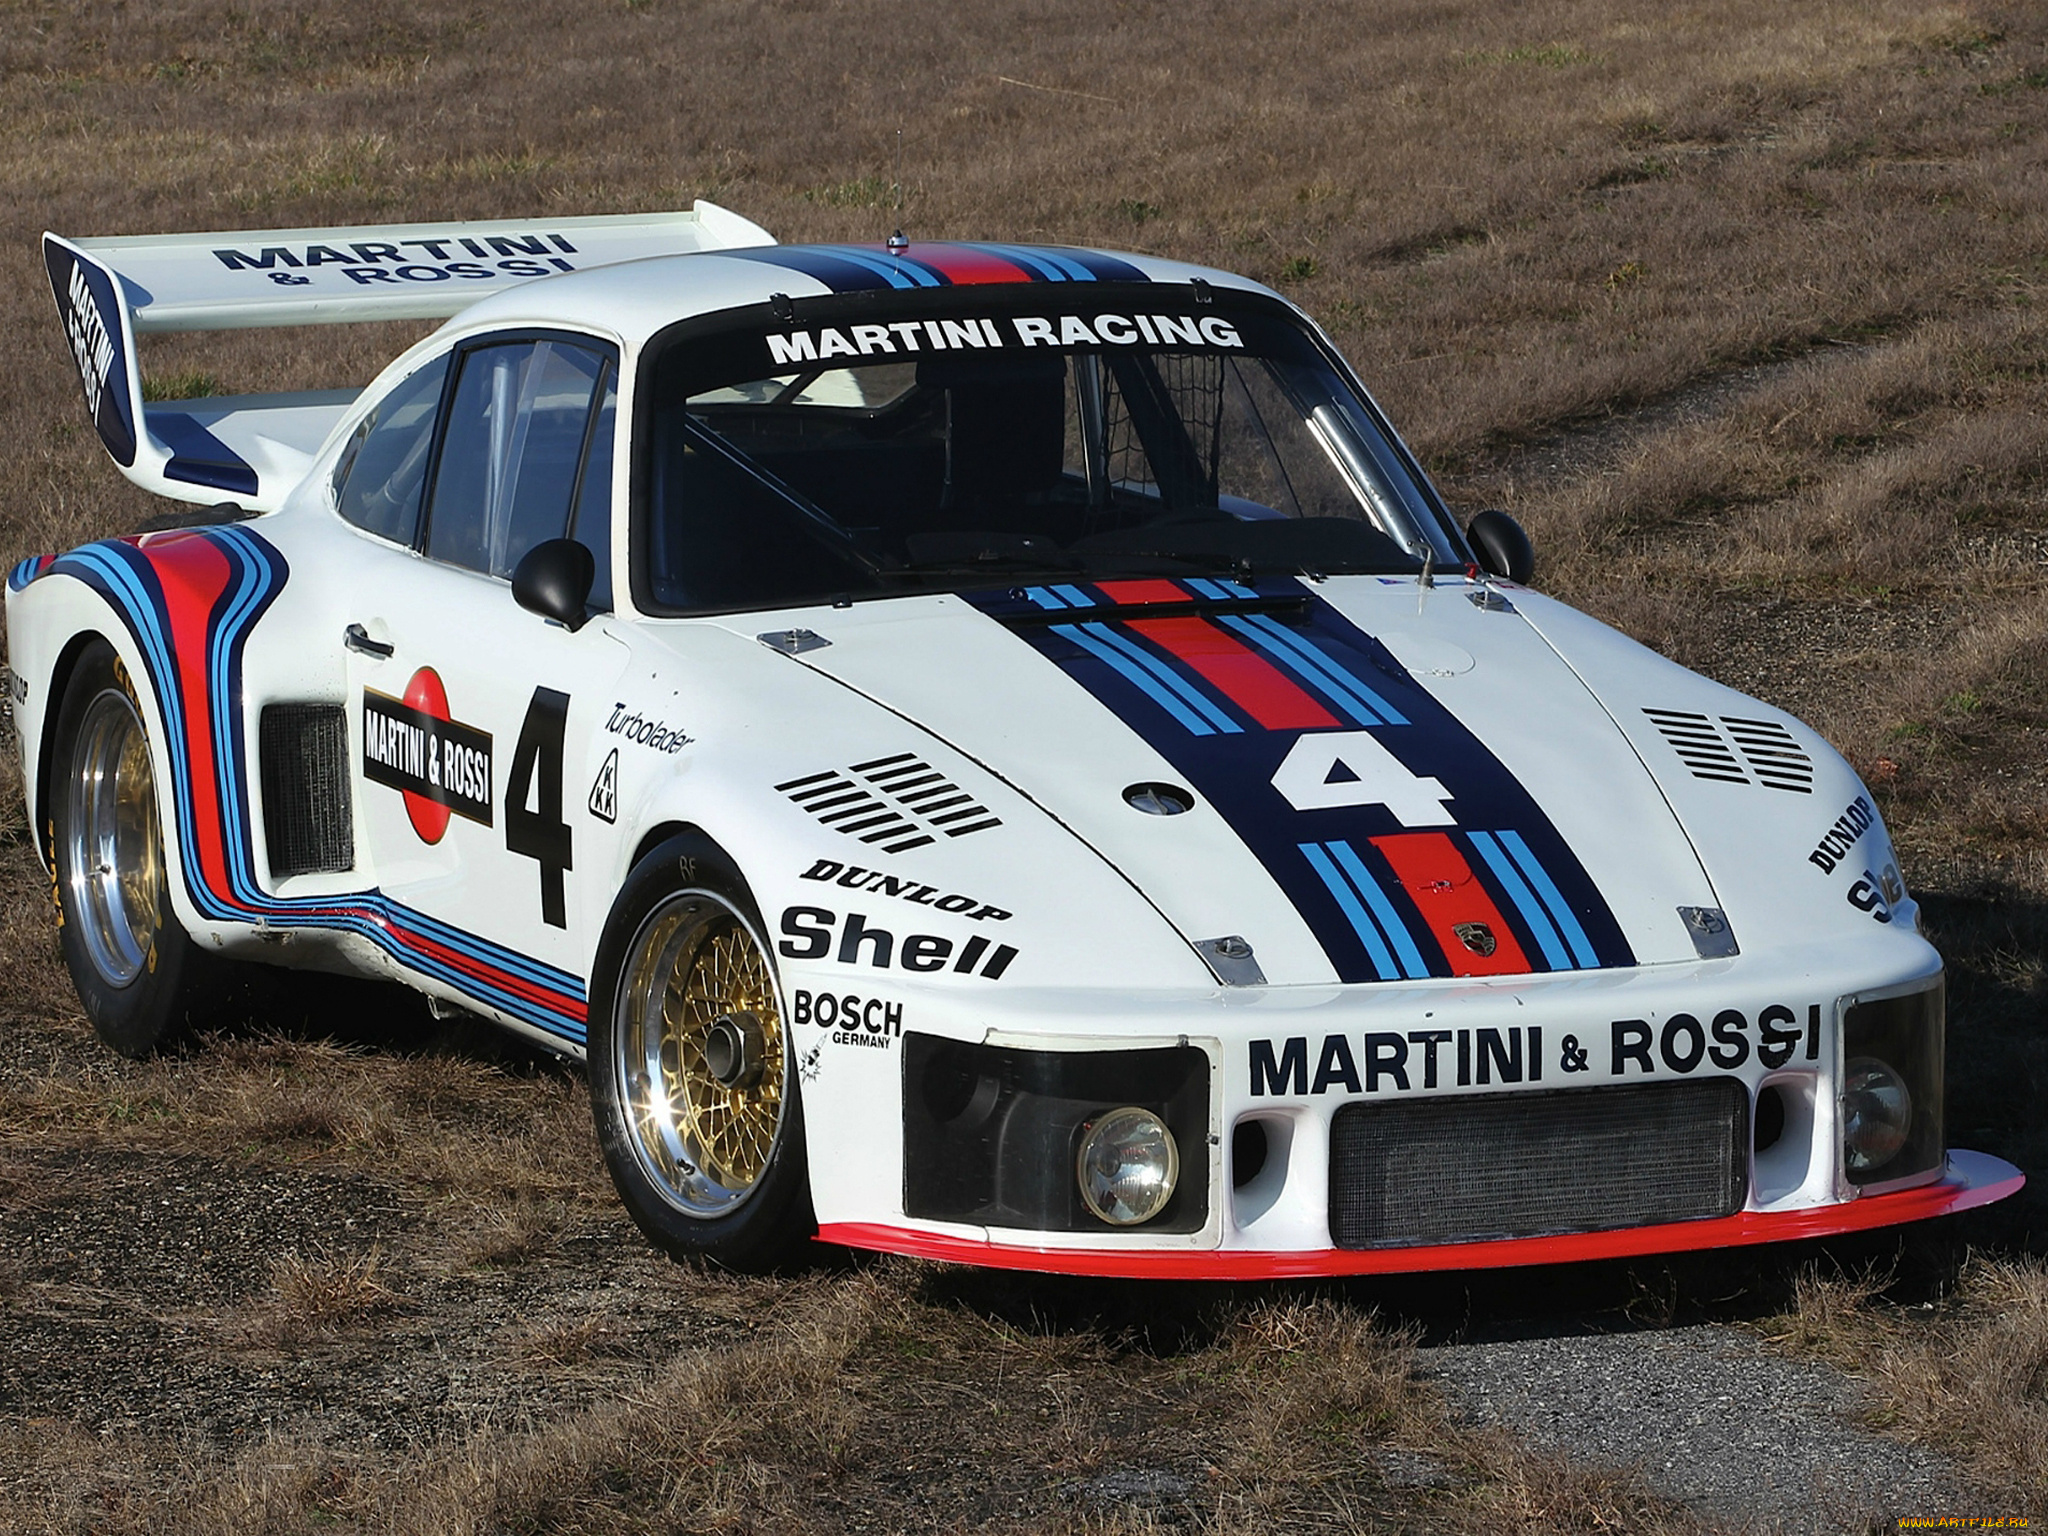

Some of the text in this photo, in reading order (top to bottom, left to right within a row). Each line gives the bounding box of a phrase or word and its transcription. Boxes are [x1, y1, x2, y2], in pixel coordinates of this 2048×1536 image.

[212, 234, 578, 270] MARTINI
[267, 258, 575, 286] & ROSSI
[69, 259, 115, 389] MARTINI
[766, 315, 1244, 364] MARTINI RACING
[366, 708, 490, 805] MARTINI & ROSSI
[605, 702, 696, 754] Turbolader
[505, 685, 573, 931] 4
[1270, 731, 1459, 827] 4
[1808, 796, 1875, 876] DUNLOP
[799, 859, 1013, 921] DUNLOP
[779, 906, 1020, 981] Shell
[795, 989, 903, 1038] BOSCH
[832, 1031, 891, 1050] GERMANY
[1249, 1004, 1820, 1096] MARTINI & ROSSI
